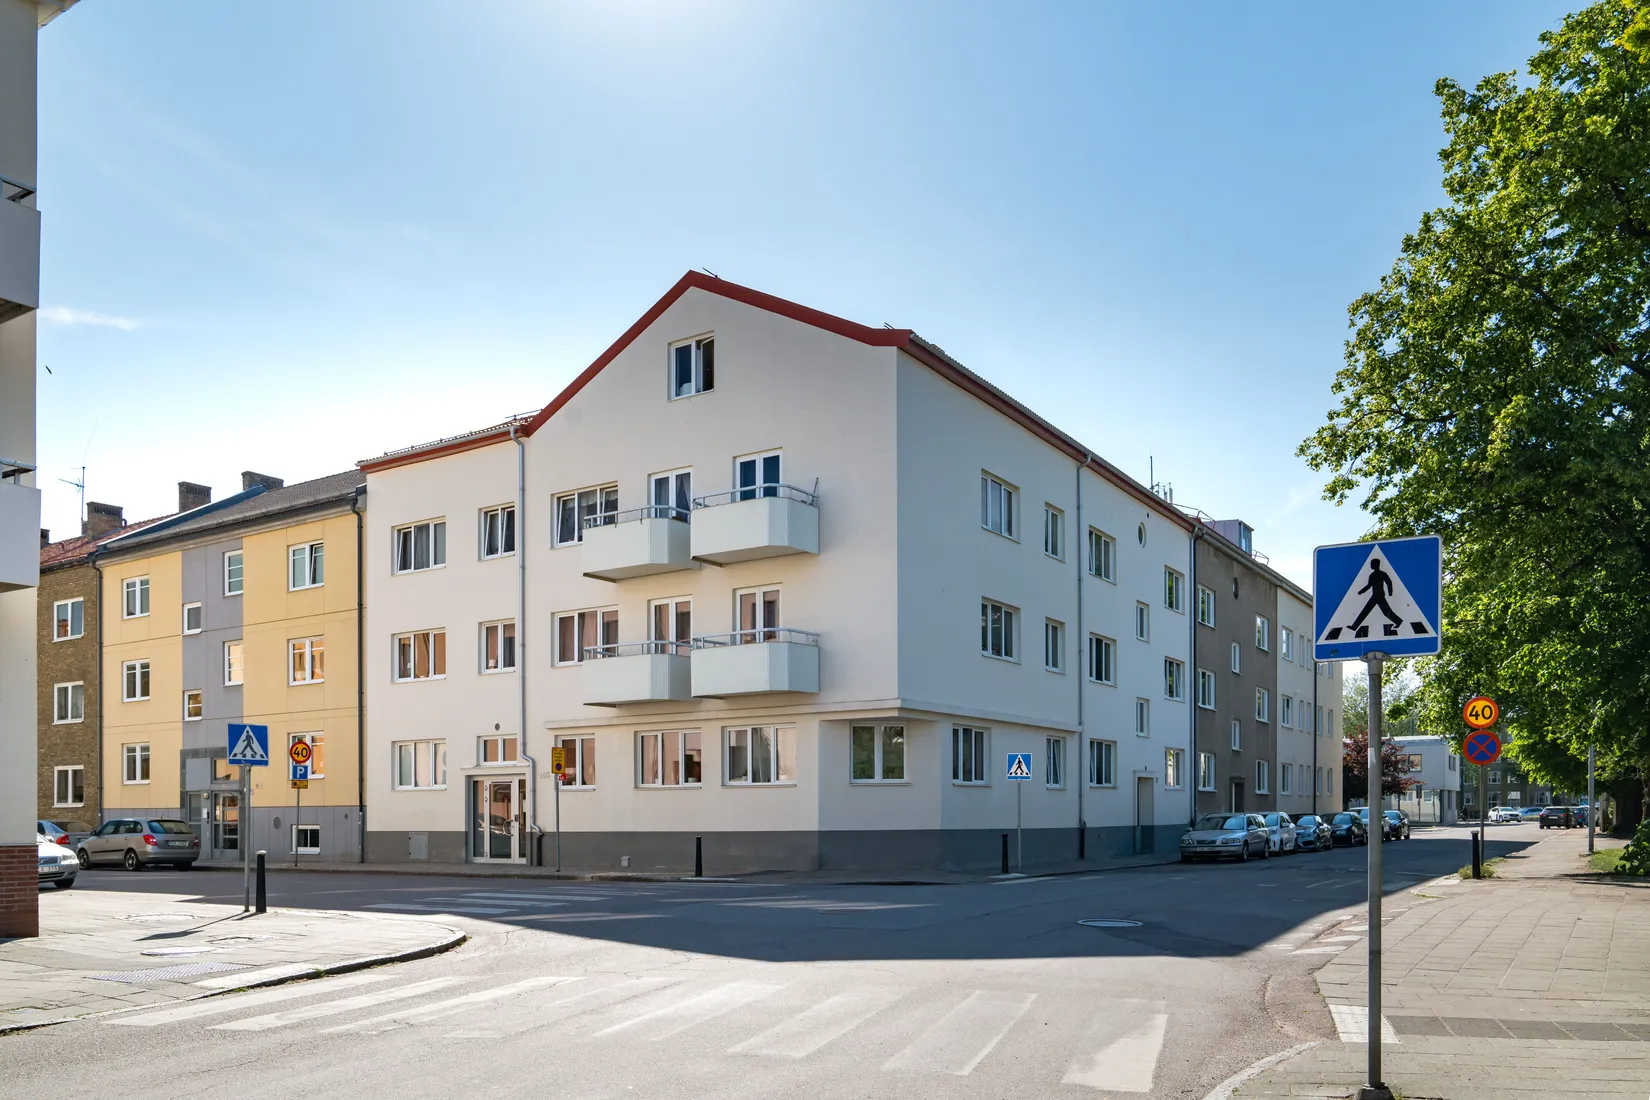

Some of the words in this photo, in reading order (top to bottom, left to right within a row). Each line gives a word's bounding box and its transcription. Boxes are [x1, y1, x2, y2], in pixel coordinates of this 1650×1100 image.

[1469, 705, 1493, 720] 40
[293, 747, 308, 757] 40
[297, 767, 305, 778] P
